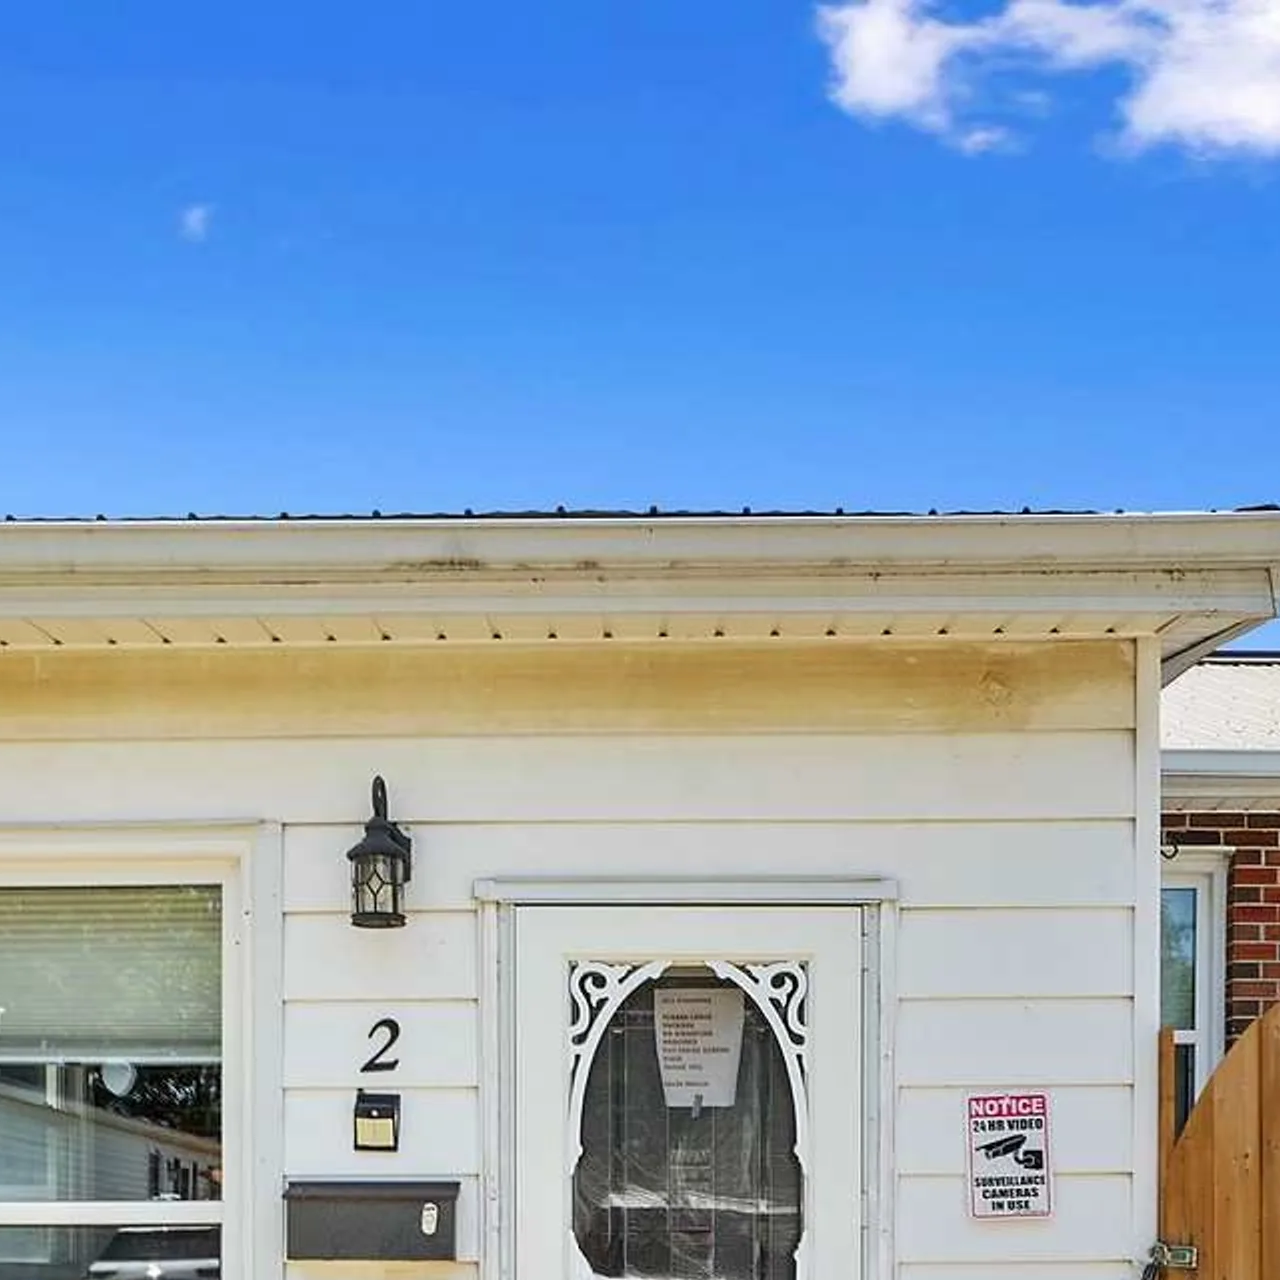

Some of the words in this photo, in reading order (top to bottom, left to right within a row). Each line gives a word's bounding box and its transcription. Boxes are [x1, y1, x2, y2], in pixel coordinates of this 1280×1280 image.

[360, 1017, 401, 1073] 2
[970, 1097, 1044, 1116] NOTICE
[973, 1119, 986, 1132] 24
[1007, 1117, 1044, 1131] VIDEO
[982, 1187, 1040, 1200] CAMERAS
[991, 1200, 1005, 1211] IN
[1007, 1199, 1031, 1211] USE
